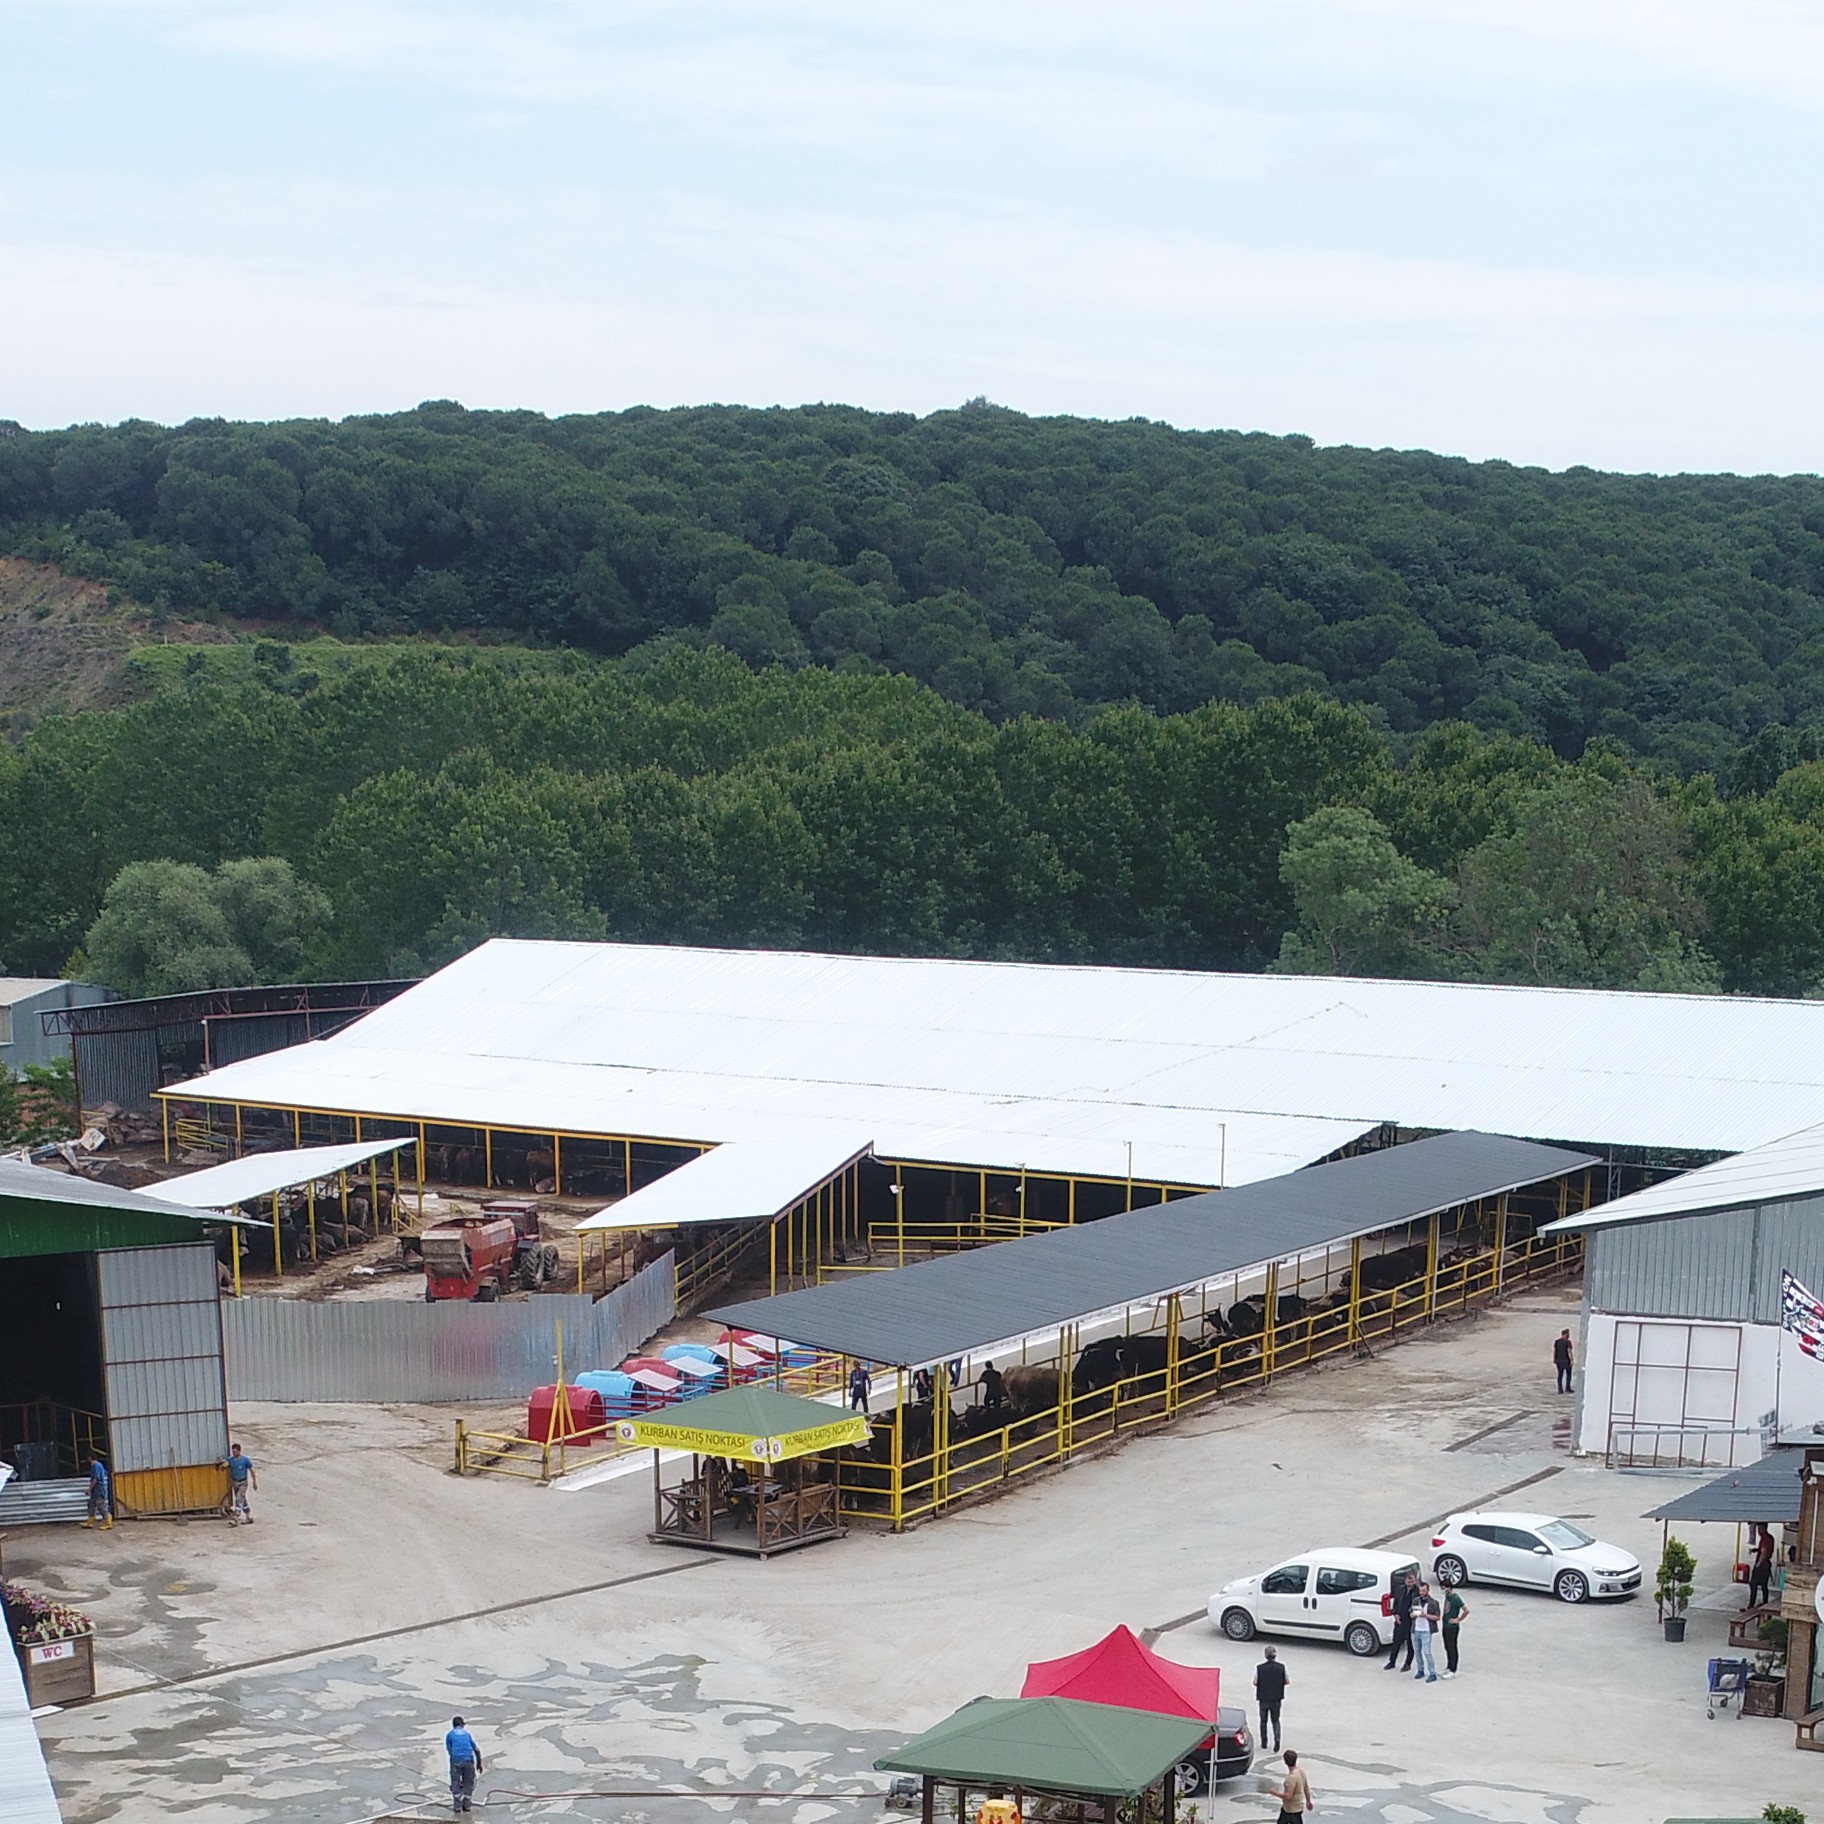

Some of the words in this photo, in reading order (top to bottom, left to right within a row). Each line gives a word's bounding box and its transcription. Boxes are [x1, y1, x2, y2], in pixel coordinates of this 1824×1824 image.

[640, 1425, 678, 1440] KURBAN
[679, 1430, 704, 1445] SATIŞ
[706, 1433, 746, 1448] NOKTASI
